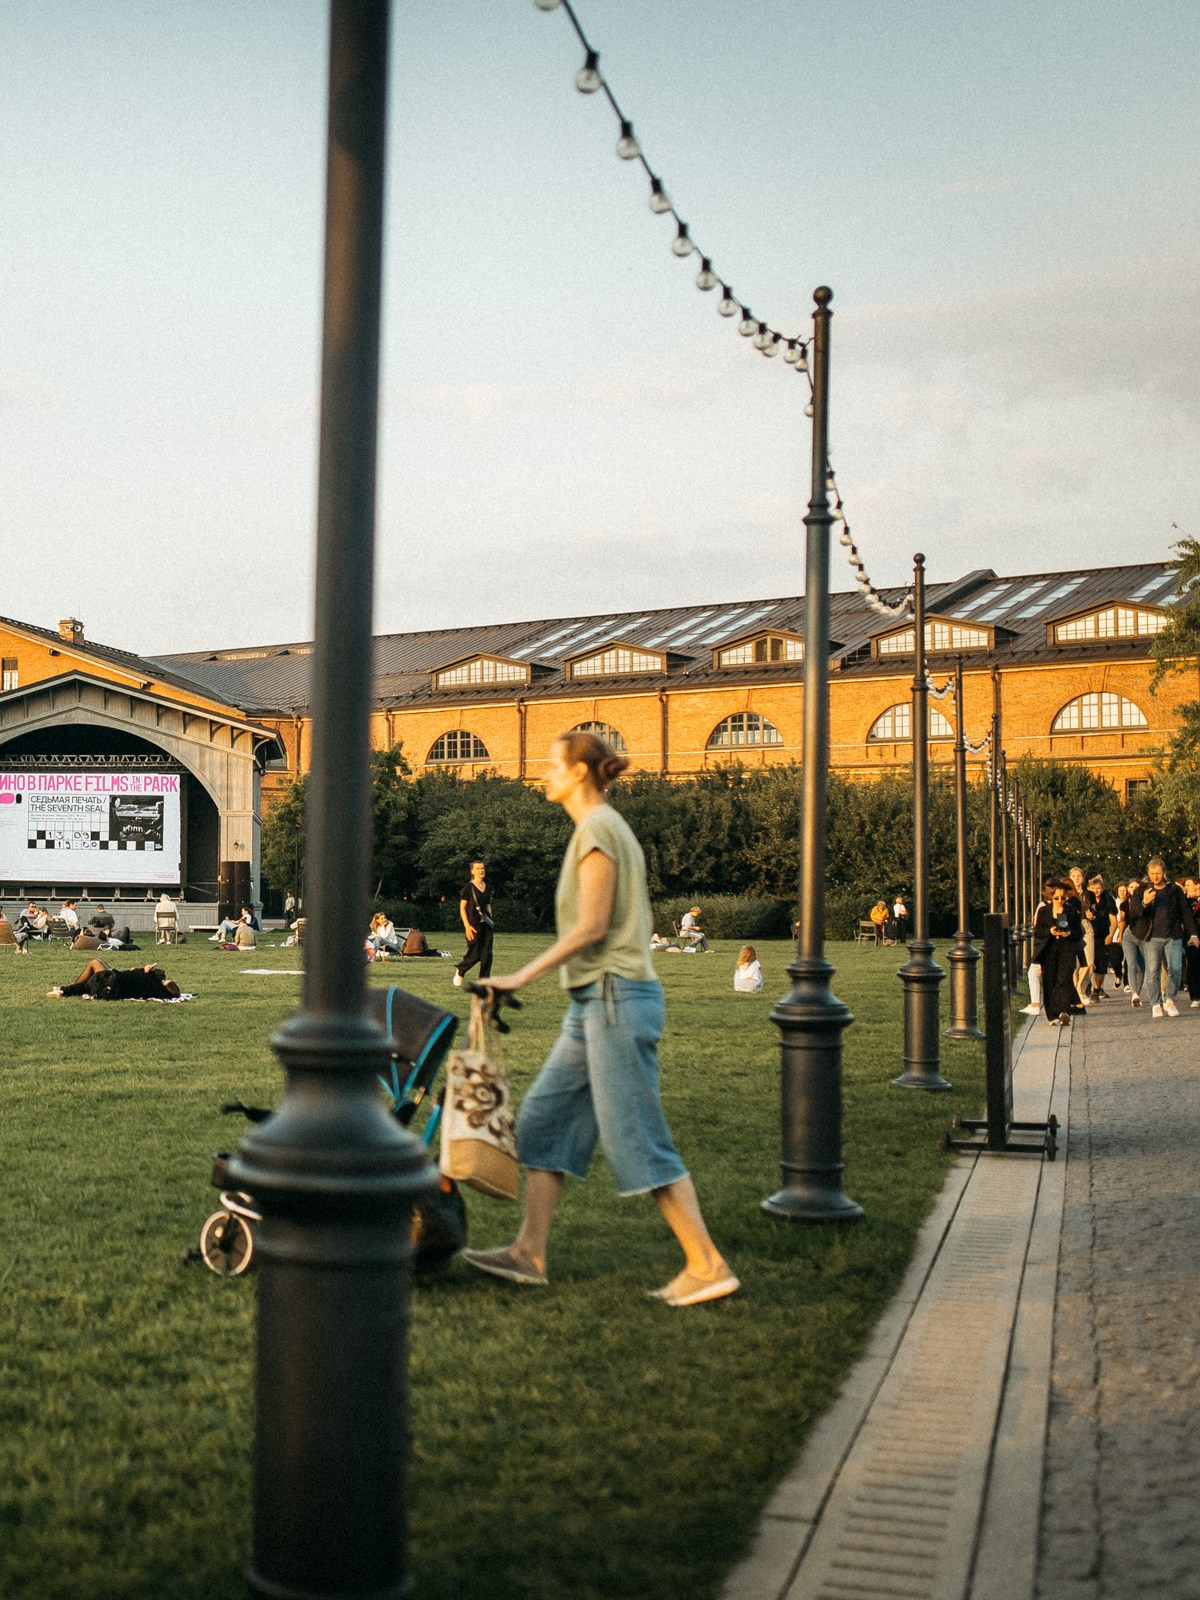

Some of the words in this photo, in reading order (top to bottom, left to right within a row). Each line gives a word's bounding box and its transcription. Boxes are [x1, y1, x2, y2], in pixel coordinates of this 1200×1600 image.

[27, 775, 37, 791] В
[38, 775, 83, 791] ПАРКЕ
[85, 775, 129, 792] FILMS
[132, 776, 141, 784] IN
[143, 776, 178, 792] PARK
[129, 783, 142, 792] THE
[30, 795, 70, 804] СЕДЬМАЯ
[71, 796, 102, 804] ПЕЧАТЬ
[30, 804, 46, 812] THE
[47, 804, 84, 812] SEVENTH
[85, 804, 105, 812] SEAL
